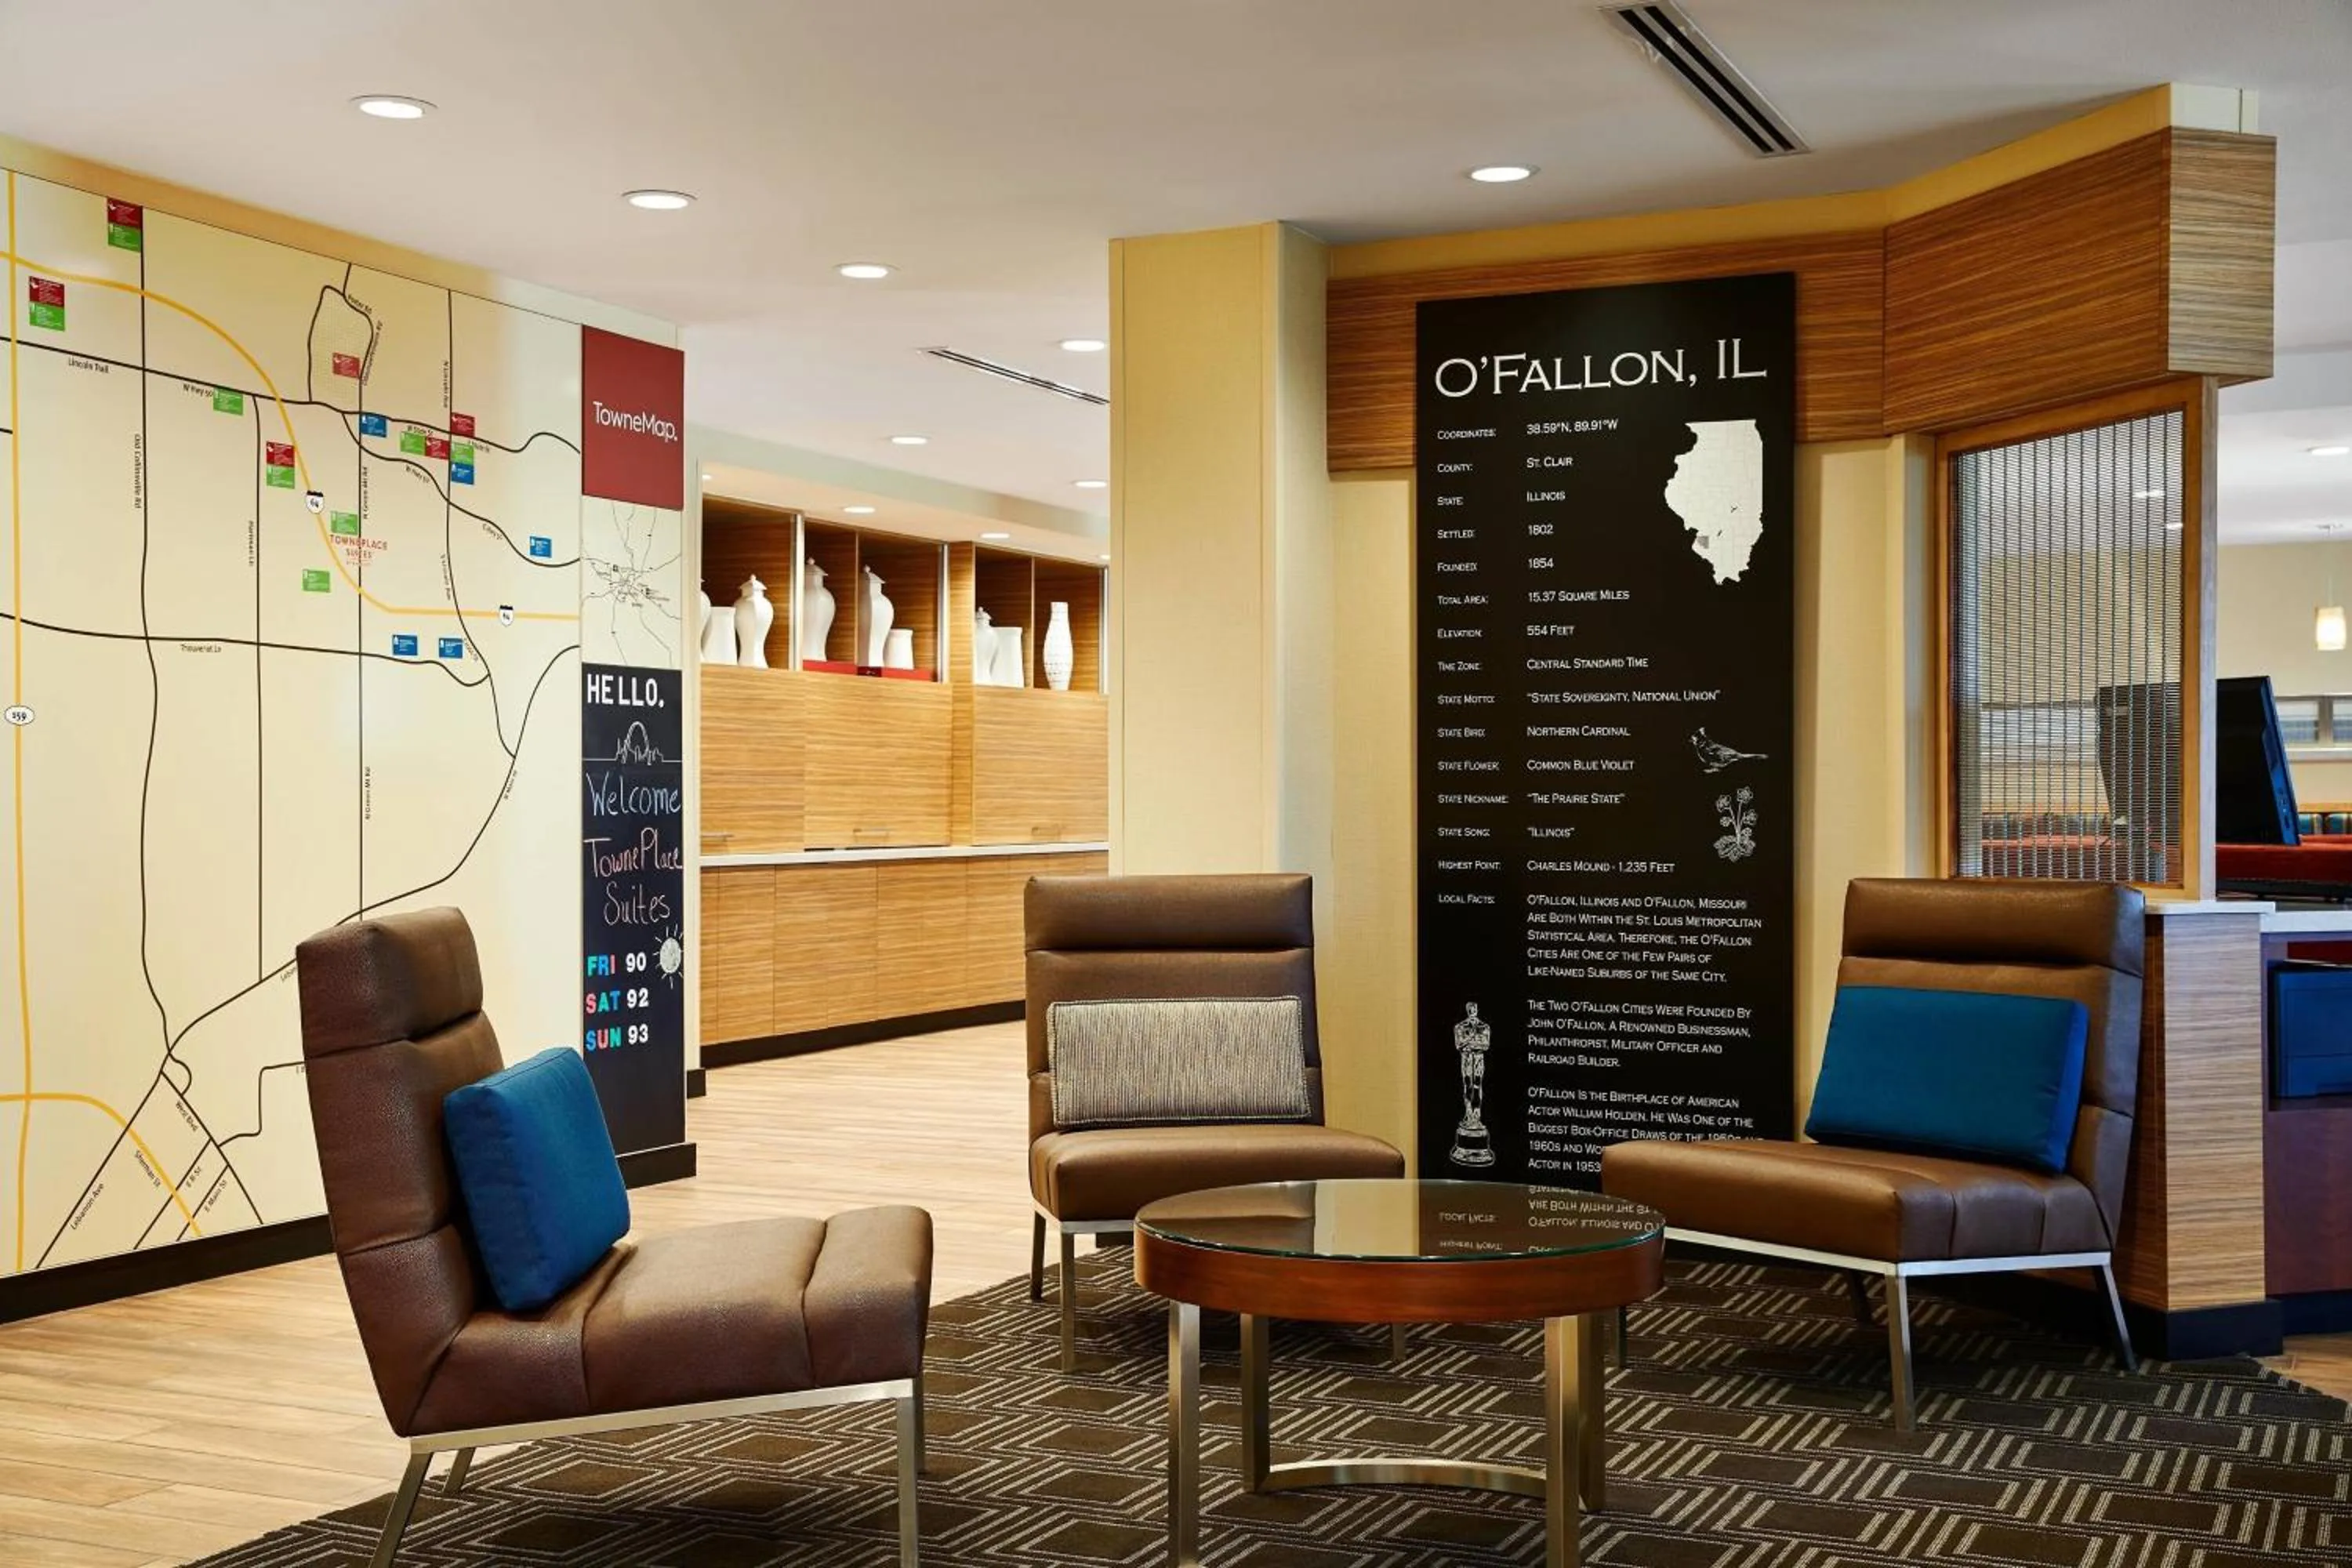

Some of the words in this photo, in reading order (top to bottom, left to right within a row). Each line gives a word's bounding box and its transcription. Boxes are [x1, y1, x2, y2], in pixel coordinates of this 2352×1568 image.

[1435, 349, 1697, 397] O'FALLON,
[1718, 338, 1767, 379] IL
[1543, 456, 1573, 468] CLAIR
[1526, 490, 1566, 503] ILLINOIS
[1528, 523, 1554, 536] 1802
[1528, 557, 1555, 569] 1854
[1528, 590, 1556, 603] 15.37
[1558, 590, 1598, 602] SQUARE
[1599, 589, 1631, 601] MILES
[1526, 625, 1548, 636] 554
[1549, 624, 1575, 636] FEET
[1526, 658, 1572, 670] CENTRAL
[1573, 657, 1625, 669] STANDARD
[1625, 656, 1649, 668] TIME
[1562, 691, 1630, 703] SOVEREIGNTY,
[1632, 691, 1682, 702] NATIONAL
[1526, 726, 1580, 737] NORTHERN
[1581, 724, 1632, 737] CARDINAL
[1526, 759, 1572, 771] COMMON
[1573, 759, 1599, 771] BLUE
[1600, 759, 1635, 771] VIOLET
[586, 771, 681, 816] Welcome
[1552, 793, 1589, 804] PRAIRIE
[1526, 860, 1572, 871] CHARLES
[1573, 860, 1611, 873] MOUND
[1649, 862, 1675, 873] FEET
[604, 880, 671, 927] Suites
[1580, 895, 1620, 908] ILLINOIS
[1621, 897, 1642, 908] AND
[1698, 897, 1748, 910] MISSOURI
[1526, 912, 1548, 924] ARE
[1548, 912, 1577, 924] BOTH
[1578, 913, 1613, 924] WITHIN
[1614, 915, 1634, 926] THE
[1653, 915, 1684, 927] LOUIS
[1685, 915, 1762, 928] METROPOLITAN
[1526, 929, 1586, 942] STATISTICAL
[1617, 931, 1677, 946] THEREFORE,
[1679, 935, 1699, 945] THE
[1526, 946, 1559, 959] CITIES
[1559, 948, 1580, 960] ARE
[1581, 949, 1605, 960] ONE
[1605, 951, 1621, 960] OF
[1621, 951, 1641, 962] THE
[1642, 950, 1666, 963] FEW
[1667, 951, 1697, 964] PAIRS
[1697, 953, 1713, 964] OF
[587, 953, 616, 976] FRI
[626, 951, 648, 973] 90
[1587, 966, 1633, 979] SUBURBS
[1634, 970, 1649, 979] OF
[1650, 970, 1670, 981] THE
[1671, 969, 1700, 982] SAME
[585, 989, 621, 1014] SAT
[626, 988, 649, 1009] 92
[1526, 999, 1546, 1011] THE
[1547, 1000, 1570, 1012] TWO
[1621, 1003, 1654, 1015] CITIES
[1655, 1004, 1685, 1017] WERE
[1686, 1004, 1736, 1018] FOUNDED
[1737, 1007, 1752, 1019] BY
[1526, 1017, 1555, 1029] JOHN
[1608, 1020, 1617, 1032] A
[1618, 1020, 1675, 1034] RENOWNED
[1677, 1022, 1751, 1038] BUSINESSMAN,
[585, 1026, 622, 1051] SUN
[627, 1024, 649, 1045] 93
[1527, 1034, 1610, 1050] PHILANTHROPIST,
[1610, 1038, 1655, 1051] MILITARY
[1655, 1040, 1700, 1053] OFFICER
[1700, 1044, 1723, 1054] AND
[1528, 1051, 1576, 1065] RAILROAD
[1577, 1089, 1588, 1101] IS
[1588, 1091, 1608, 1102] THE
[1610, 1091, 1669, 1105] BIRTHPLACE
[1671, 1095, 1686, 1105] OF
[1686, 1095, 1740, 1109] AMERICAN
[1527, 1104, 1561, 1116] ACTOR
[1561, 1106, 1603, 1119] WILLIAM
[1650, 1111, 1665, 1123] HE
[1666, 1112, 1691, 1124] WAS
[1692, 1113, 1715, 1126] ONE
[1716, 1116, 1732, 1127] OF
[1733, 1116, 1754, 1129] THE
[1527, 1122, 1569, 1135] BIGGEST
[1570, 1125, 1628, 1138] BOX-OFFICE
[1632, 1128, 1667, 1141] DRAWS
[1668, 1132, 1683, 1142] OF
[1563, 1143, 1583, 1154] AND
[1528, 1157, 1561, 1170] ACTOR
[1563, 1161, 1572, 1171] IN
[1576, 1160, 1602, 1173] 1953
